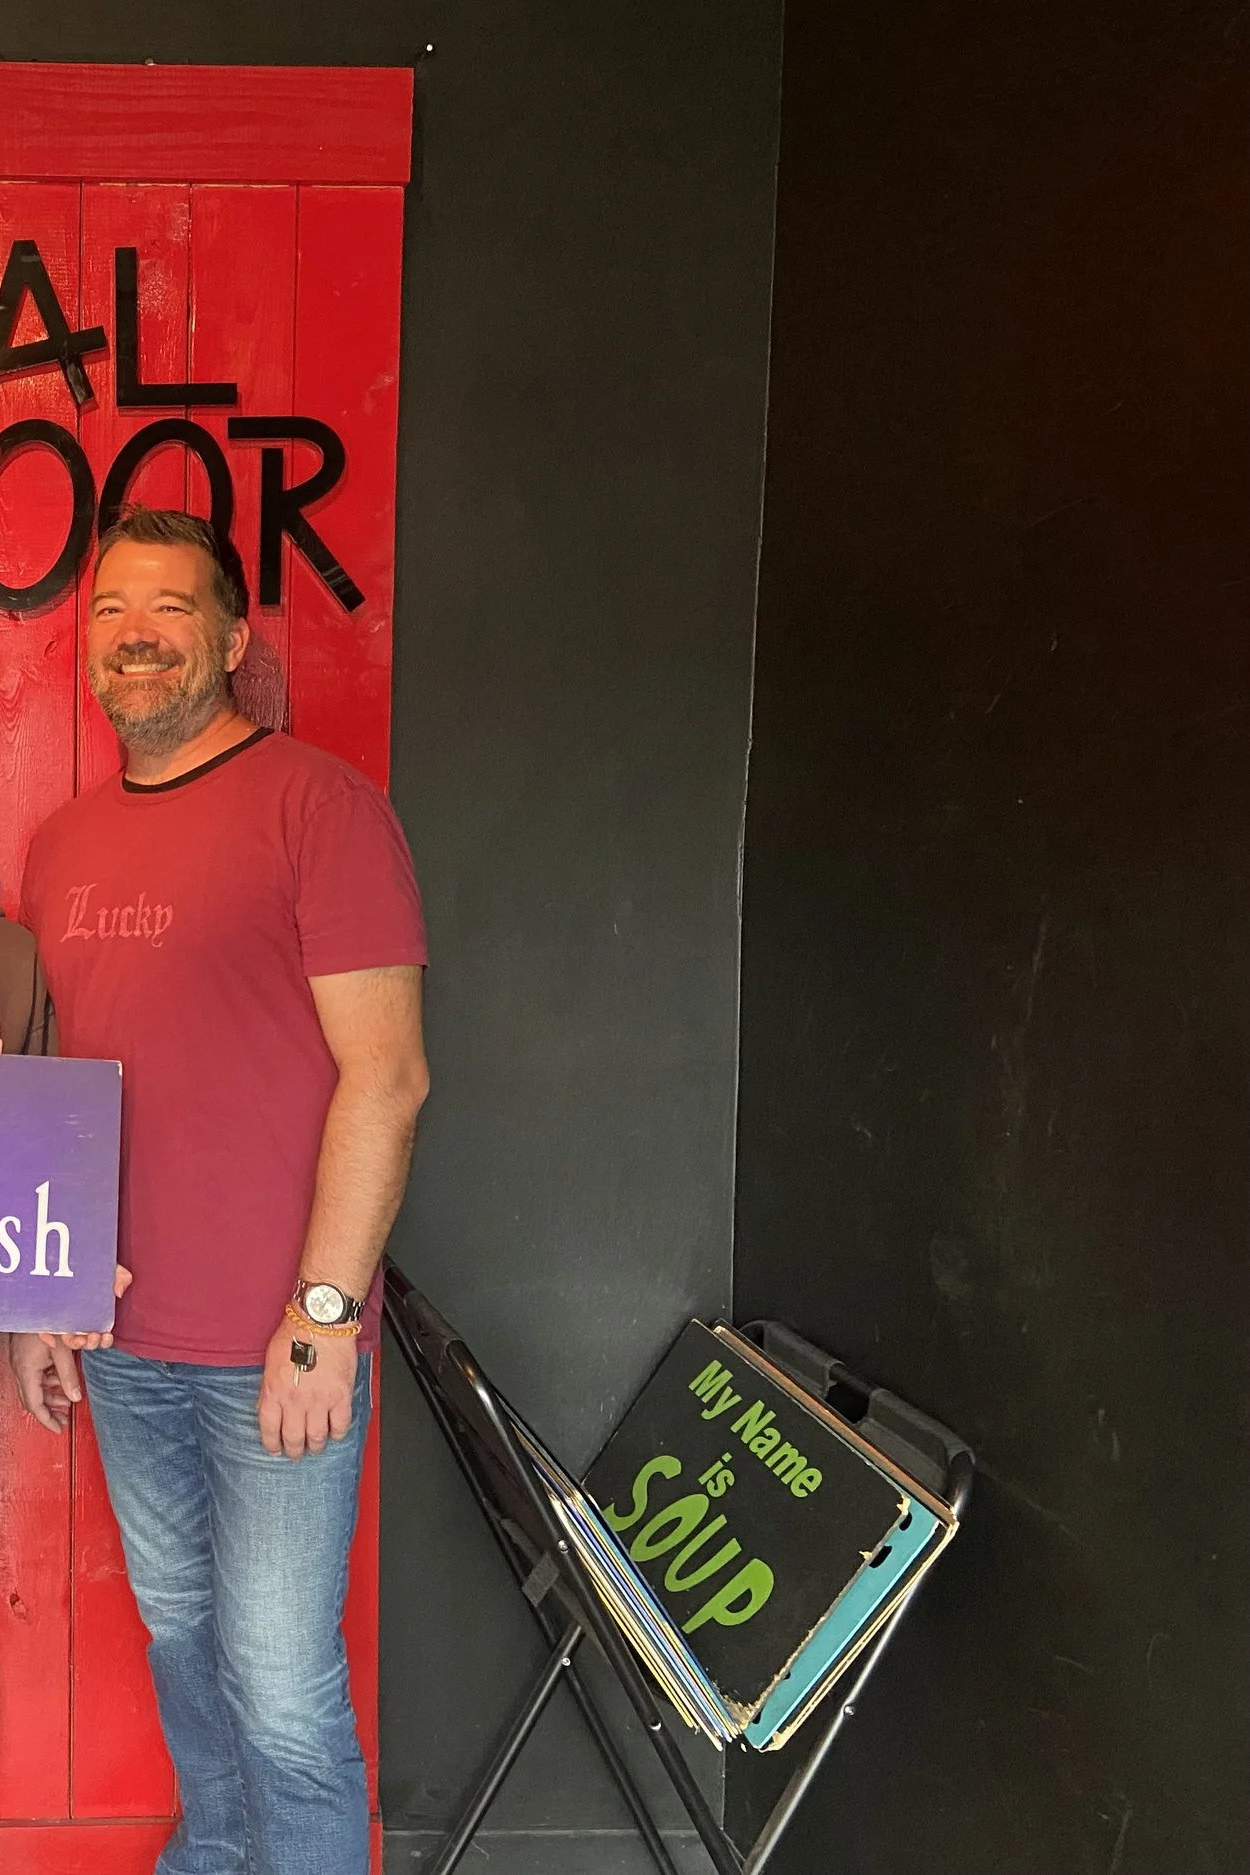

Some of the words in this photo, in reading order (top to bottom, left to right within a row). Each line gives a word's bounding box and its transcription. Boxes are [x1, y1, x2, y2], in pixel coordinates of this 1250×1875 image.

[60, 883, 174, 948] Lucky
[688, 1360, 741, 1420] My
[730, 1400, 823, 1498] Name
[698, 1453, 736, 1498] is
[601, 1454, 775, 1634] SOUP
